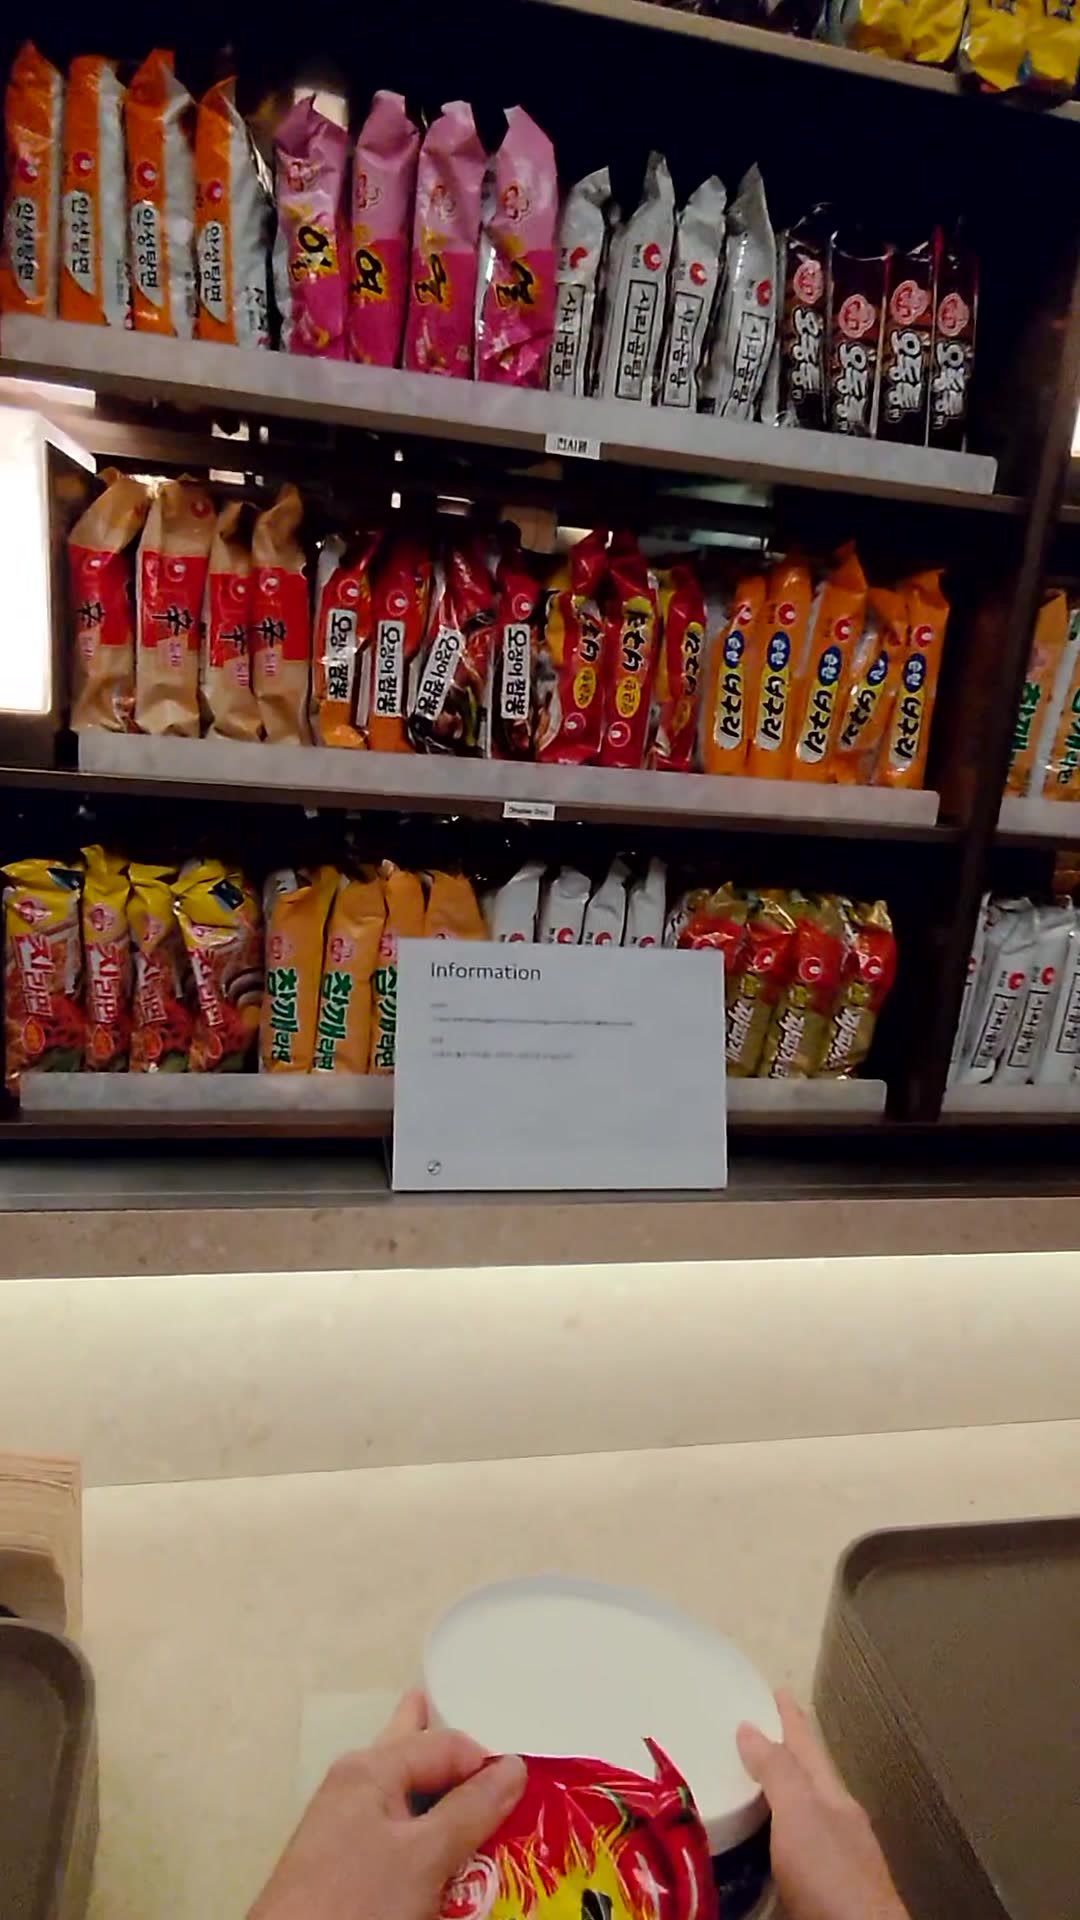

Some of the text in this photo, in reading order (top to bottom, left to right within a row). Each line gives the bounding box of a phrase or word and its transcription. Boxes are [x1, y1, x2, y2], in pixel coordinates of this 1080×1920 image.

[16, 202, 35, 281] 안성탕면
[71, 197, 91, 275] 안성탕면
[137, 208, 158, 288] 안성탕면
[204, 225, 223, 303] 안성탕면
[624, 289, 653, 381] 사리곰탕
[670, 306, 697, 389] 사리곰탕
[151, 605, 194, 637] 辛
[252, 616, 287, 648] 辛
[720, 674, 742, 738] 너구리
[761, 676, 786, 740] 너구리
[804, 690, 833, 753] 너구리
[895, 696, 921, 759] 너구리
[11, 934, 55, 1016] 진라면
[86, 943, 121, 1025] 진라면
[429, 961, 543, 982] Information
[267, 968, 298, 1064] 참깨라면
[313, 971, 353, 1071] 참깨라면
